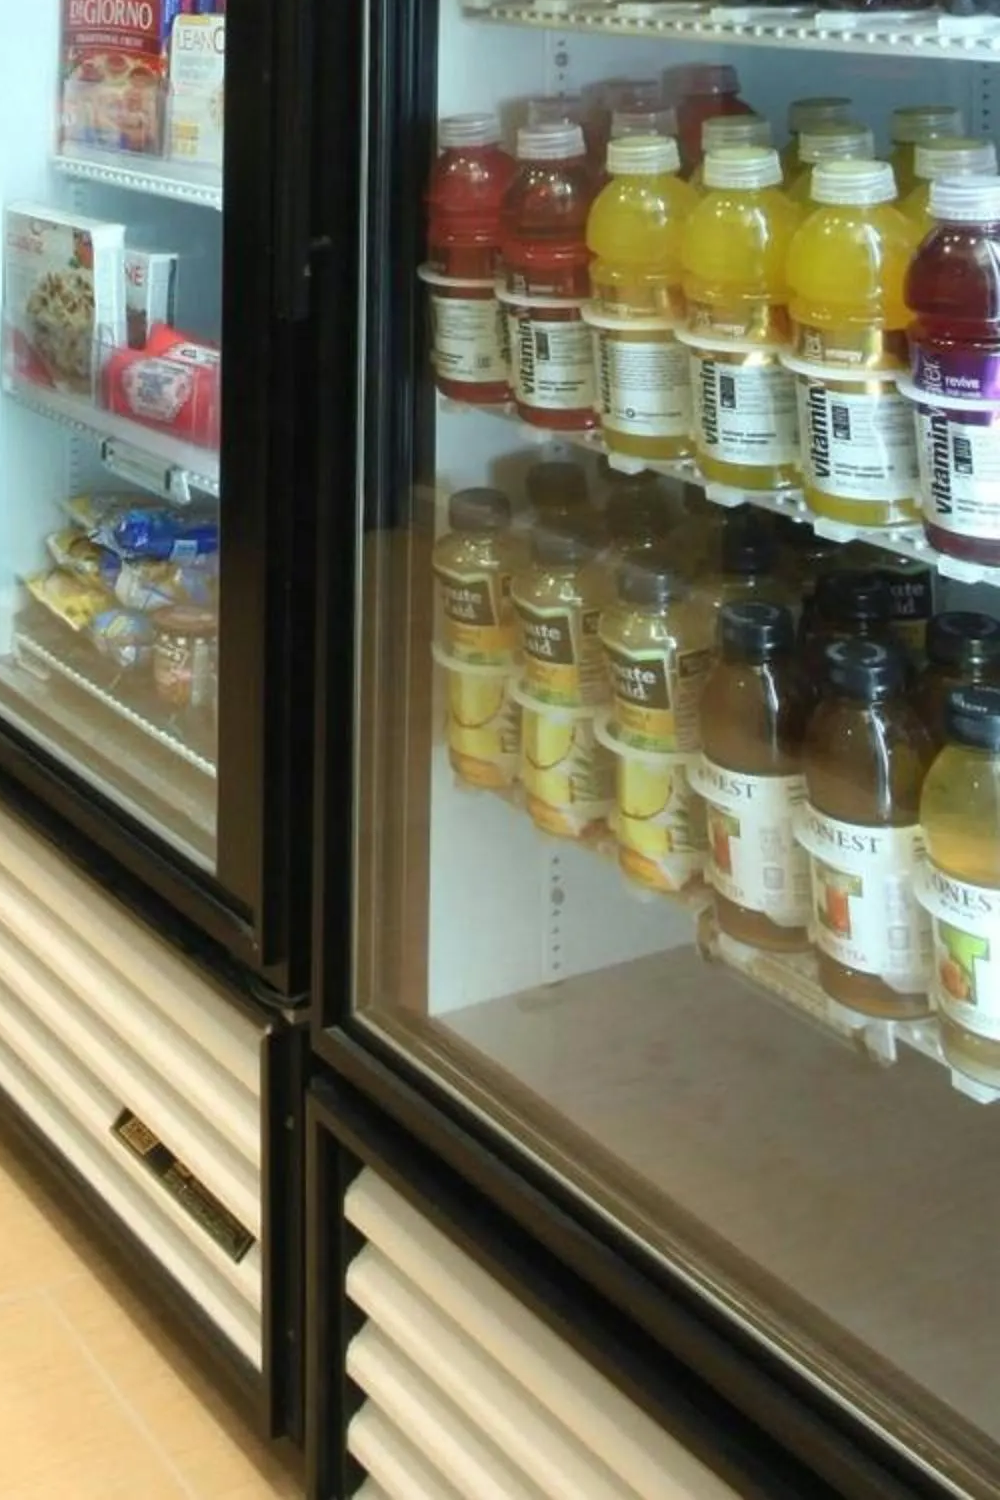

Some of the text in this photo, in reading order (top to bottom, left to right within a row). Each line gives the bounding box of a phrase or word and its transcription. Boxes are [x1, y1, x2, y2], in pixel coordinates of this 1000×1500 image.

[701, 359, 719, 445] vitamin
[944, 375, 981, 390] revive
[807, 386, 831, 479] vitamin
[927, 413, 953, 515] vitamin
